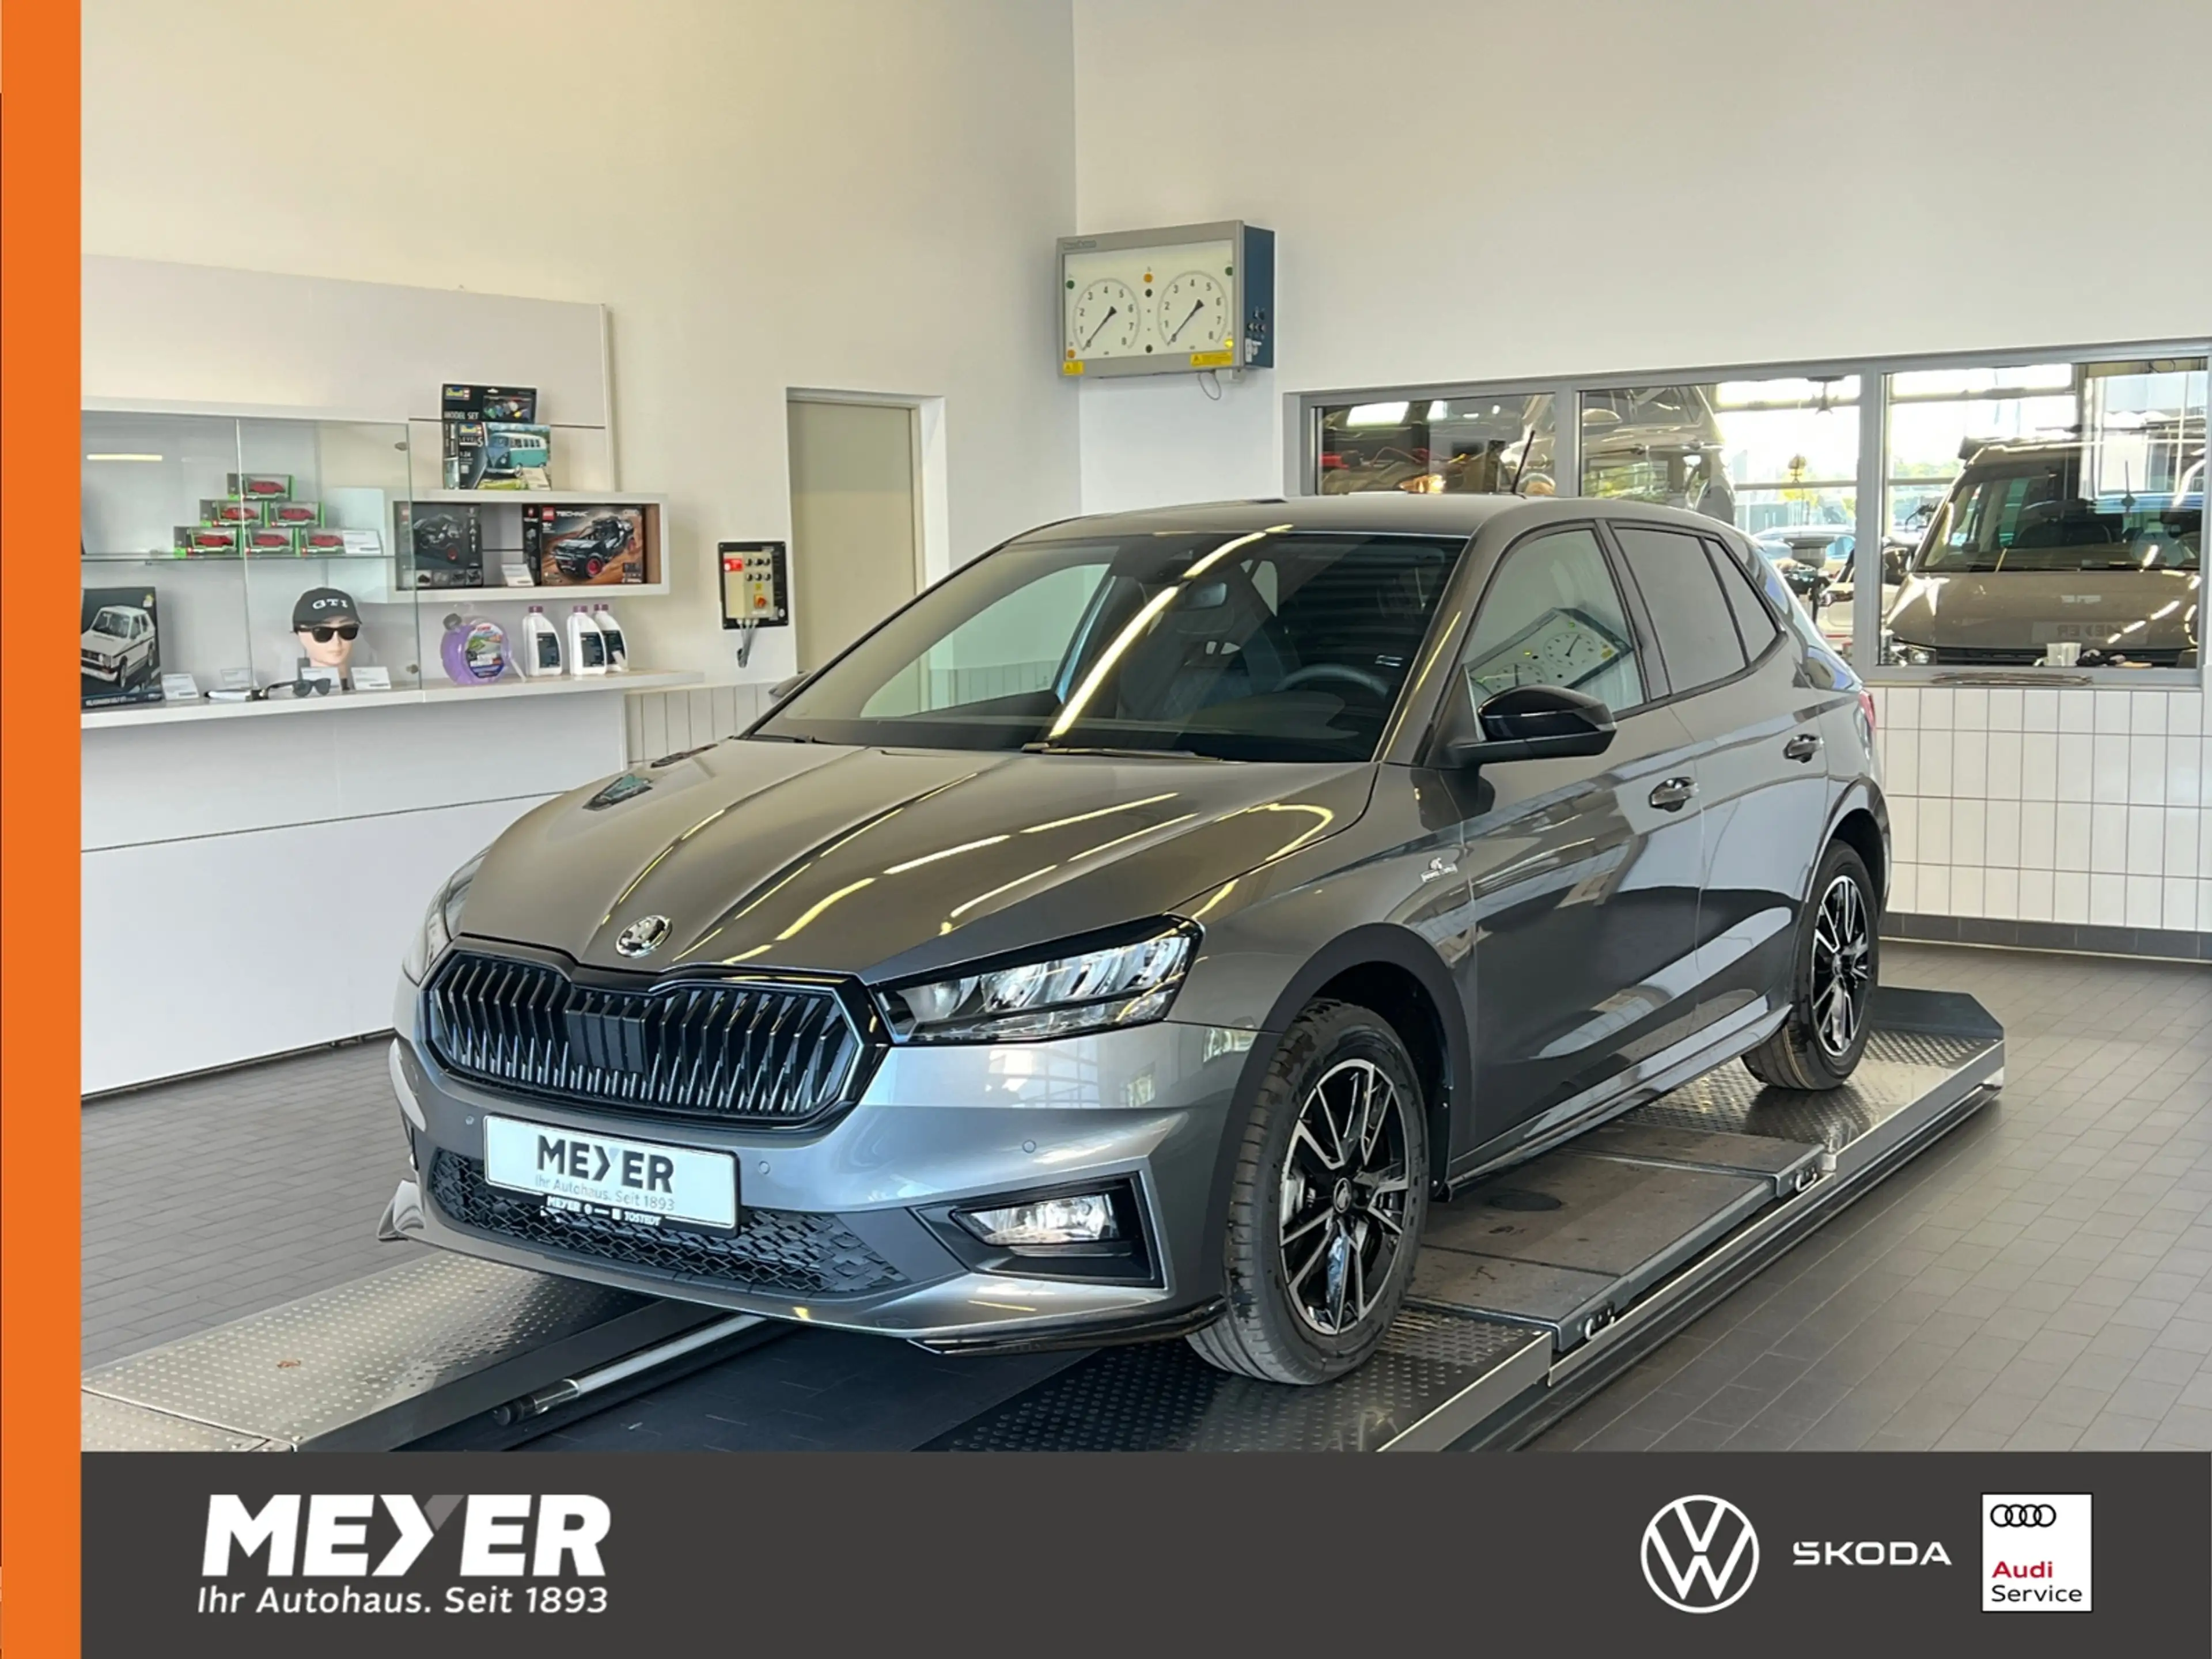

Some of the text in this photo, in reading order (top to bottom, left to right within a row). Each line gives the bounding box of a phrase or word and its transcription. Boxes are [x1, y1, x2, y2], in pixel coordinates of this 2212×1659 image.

[1190, 279, 1195, 287] 4
[1206, 282, 1211, 291] 5
[1104, 286, 1108, 294] 4
[1119, 289, 1124, 298] 5
[1173, 285, 1179, 294] 3
[1088, 291, 1093, 300] 3
[1164, 301, 1170, 310] 2
[1215, 297, 1221, 306] 6
[1080, 308, 1085, 317] 2
[1128, 304, 1134, 313] 6
[1164, 320, 1168, 328] 1
[1217, 315, 1222, 325] 7
[1080, 325, 1084, 334] 1
[1129, 321, 1134, 331] 7
[444, 411, 479, 419] MODEL SET
[313, 599, 348, 609] GTI
[536, 1134, 674, 1194] MEYER
[535, 1174, 675, 1211] Ihr Autohaus. Seit 1893
